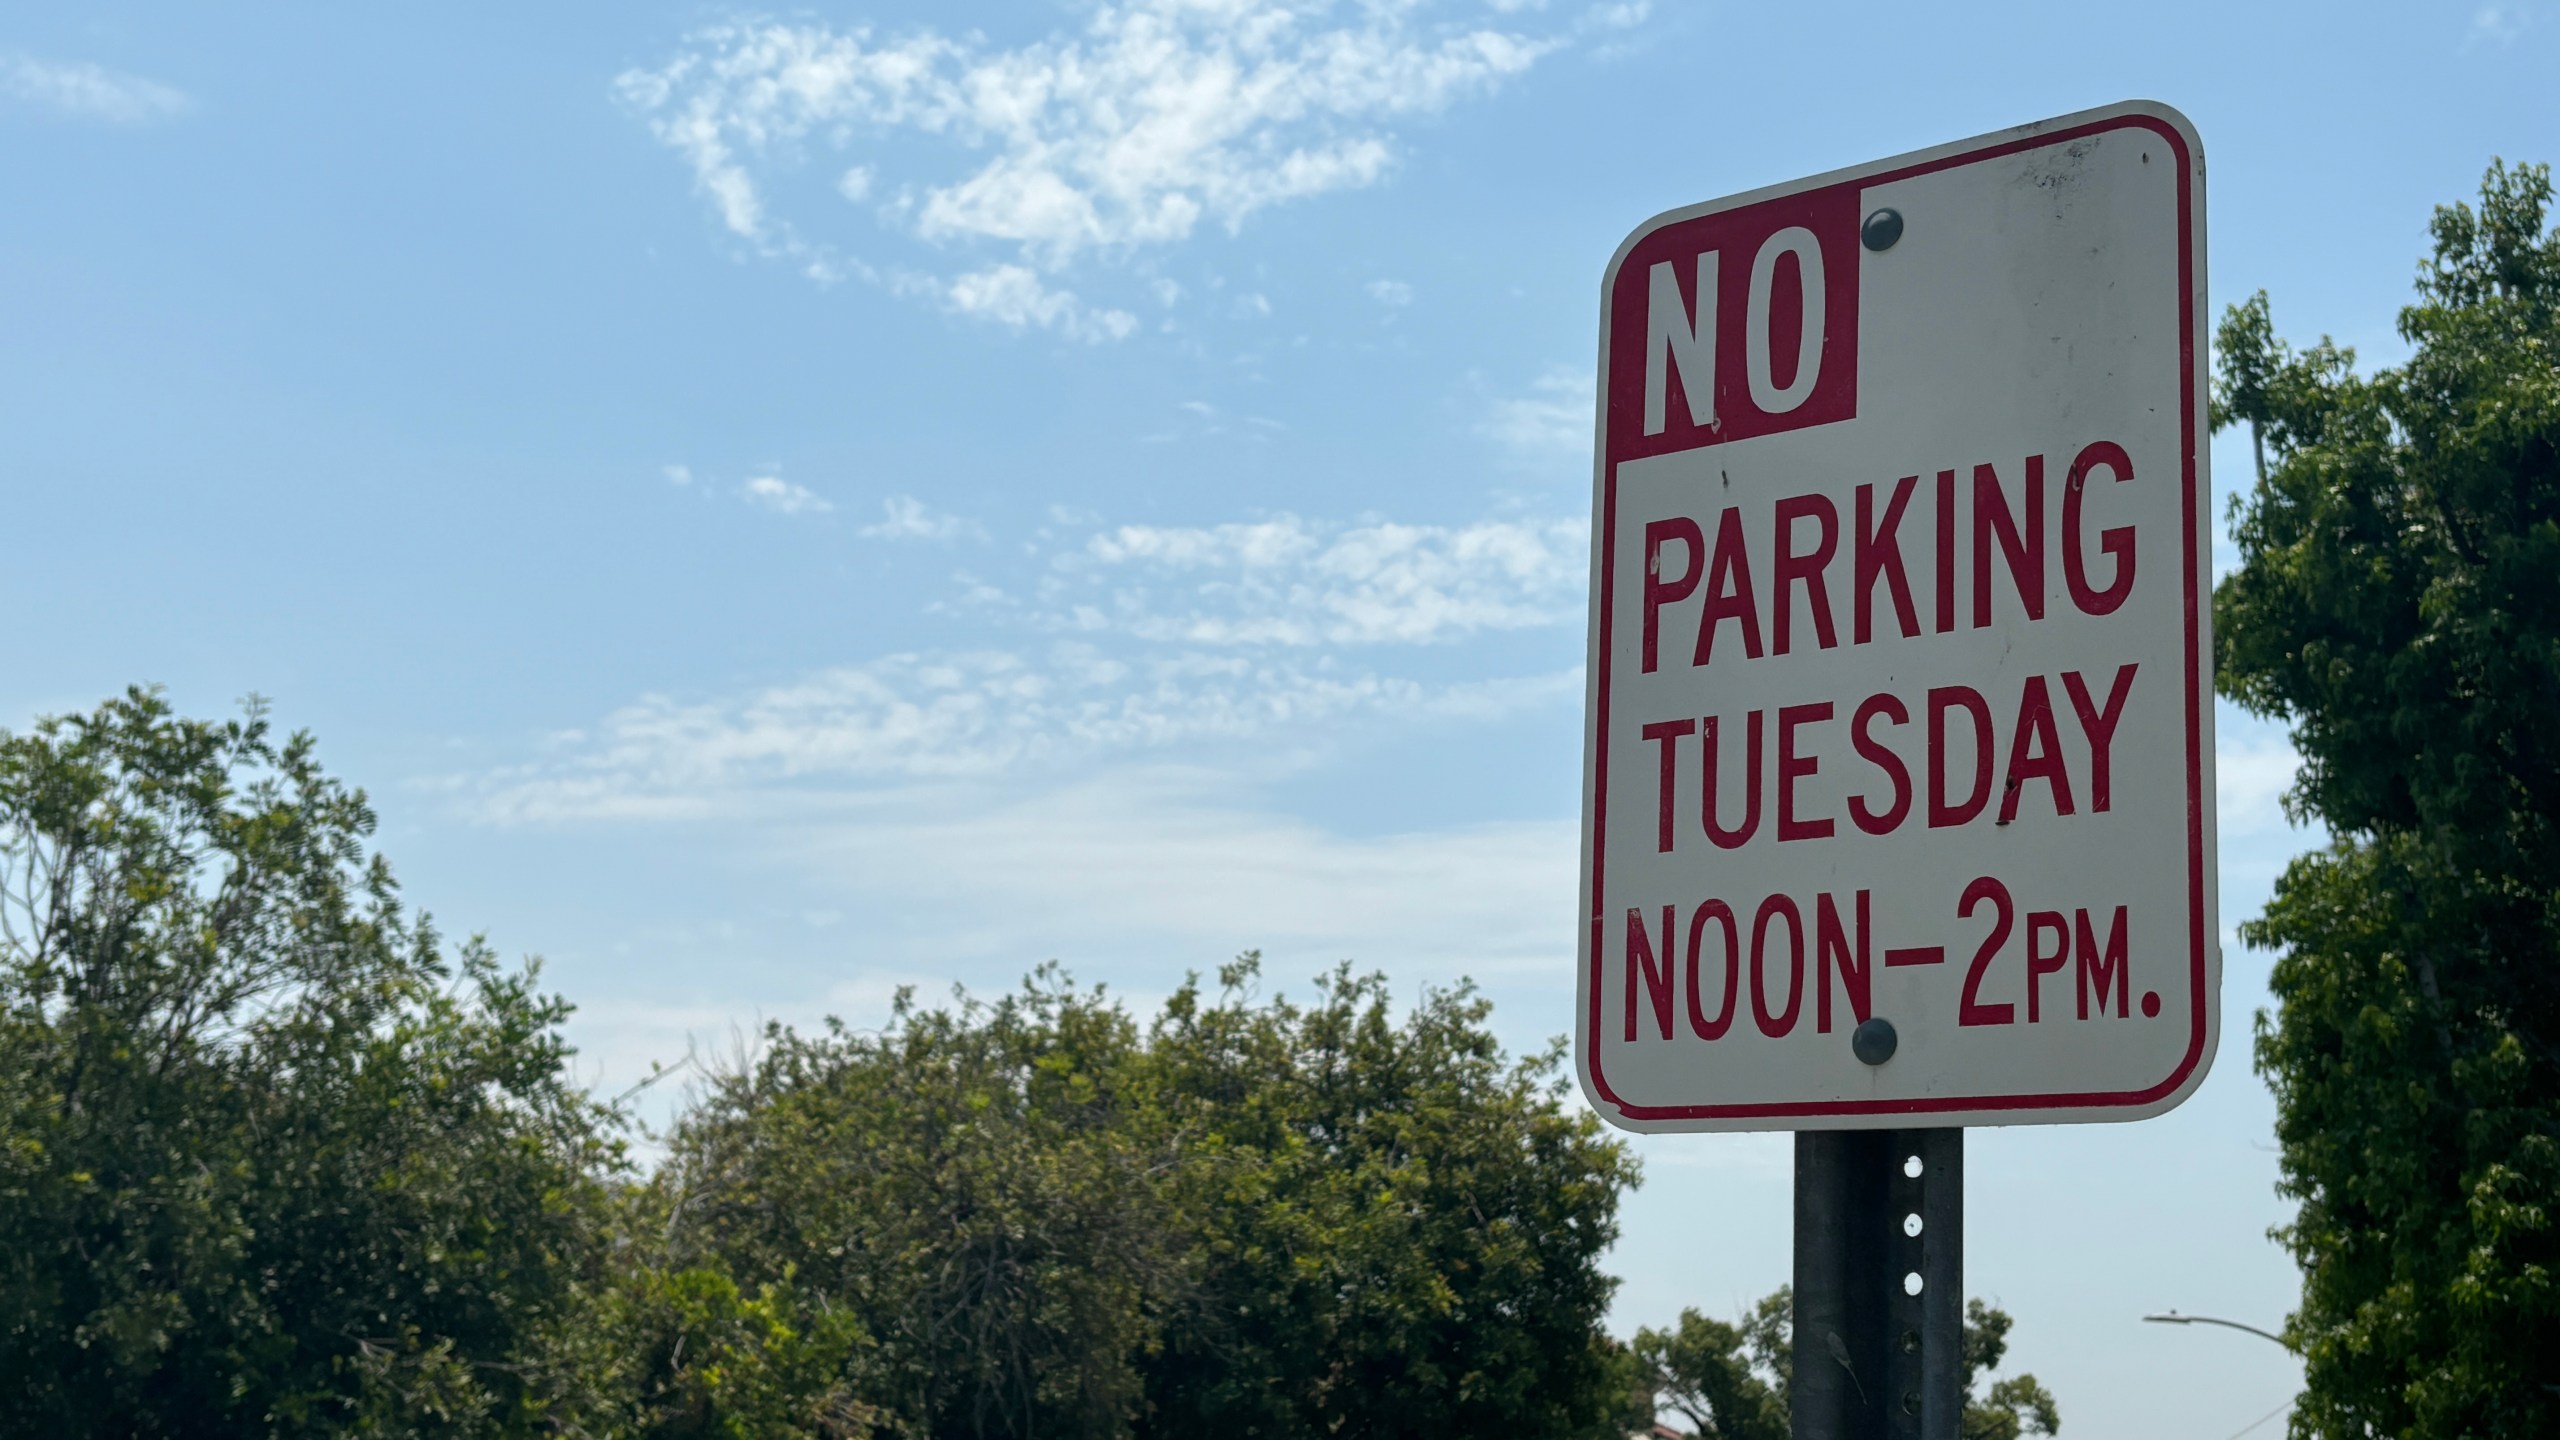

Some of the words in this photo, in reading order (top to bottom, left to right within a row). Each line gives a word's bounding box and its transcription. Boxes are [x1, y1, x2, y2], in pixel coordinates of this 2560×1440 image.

[1643, 226, 1826, 437] NO
[1642, 440, 2137, 674] PARKING
[1641, 663, 2140, 854] TUESDAY
